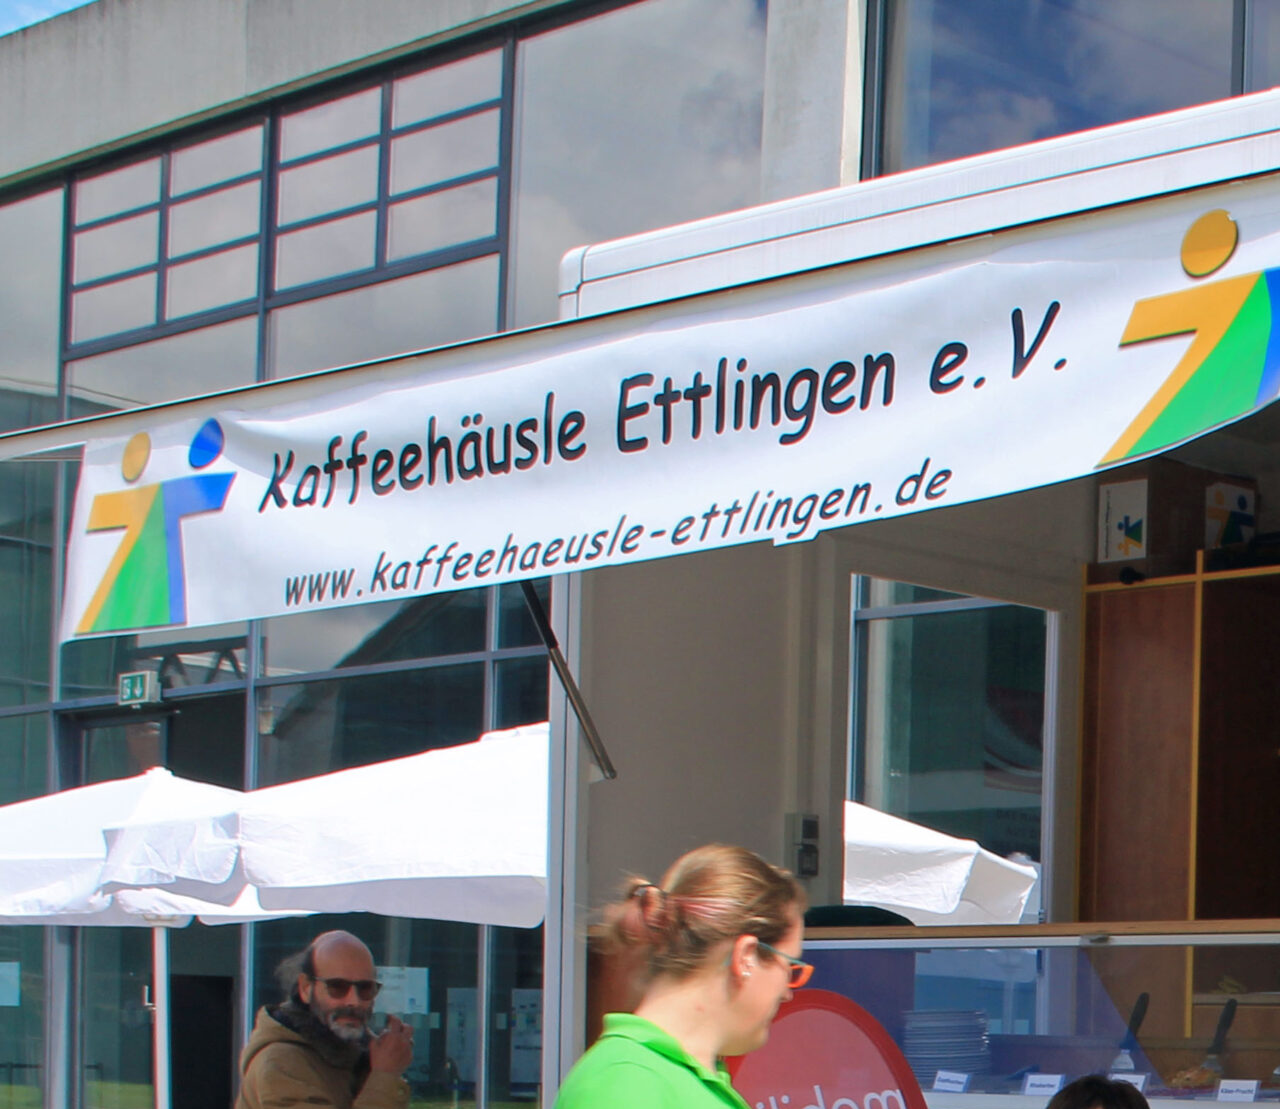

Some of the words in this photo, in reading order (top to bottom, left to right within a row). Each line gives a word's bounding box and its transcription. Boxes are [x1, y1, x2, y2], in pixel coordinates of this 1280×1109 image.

[257, 391, 588, 513] Kaffeehäusle
[616, 351, 897, 453] Ettlingen
[285, 457, 953, 607] www.kaffeehaeusle-ettlingen.de
